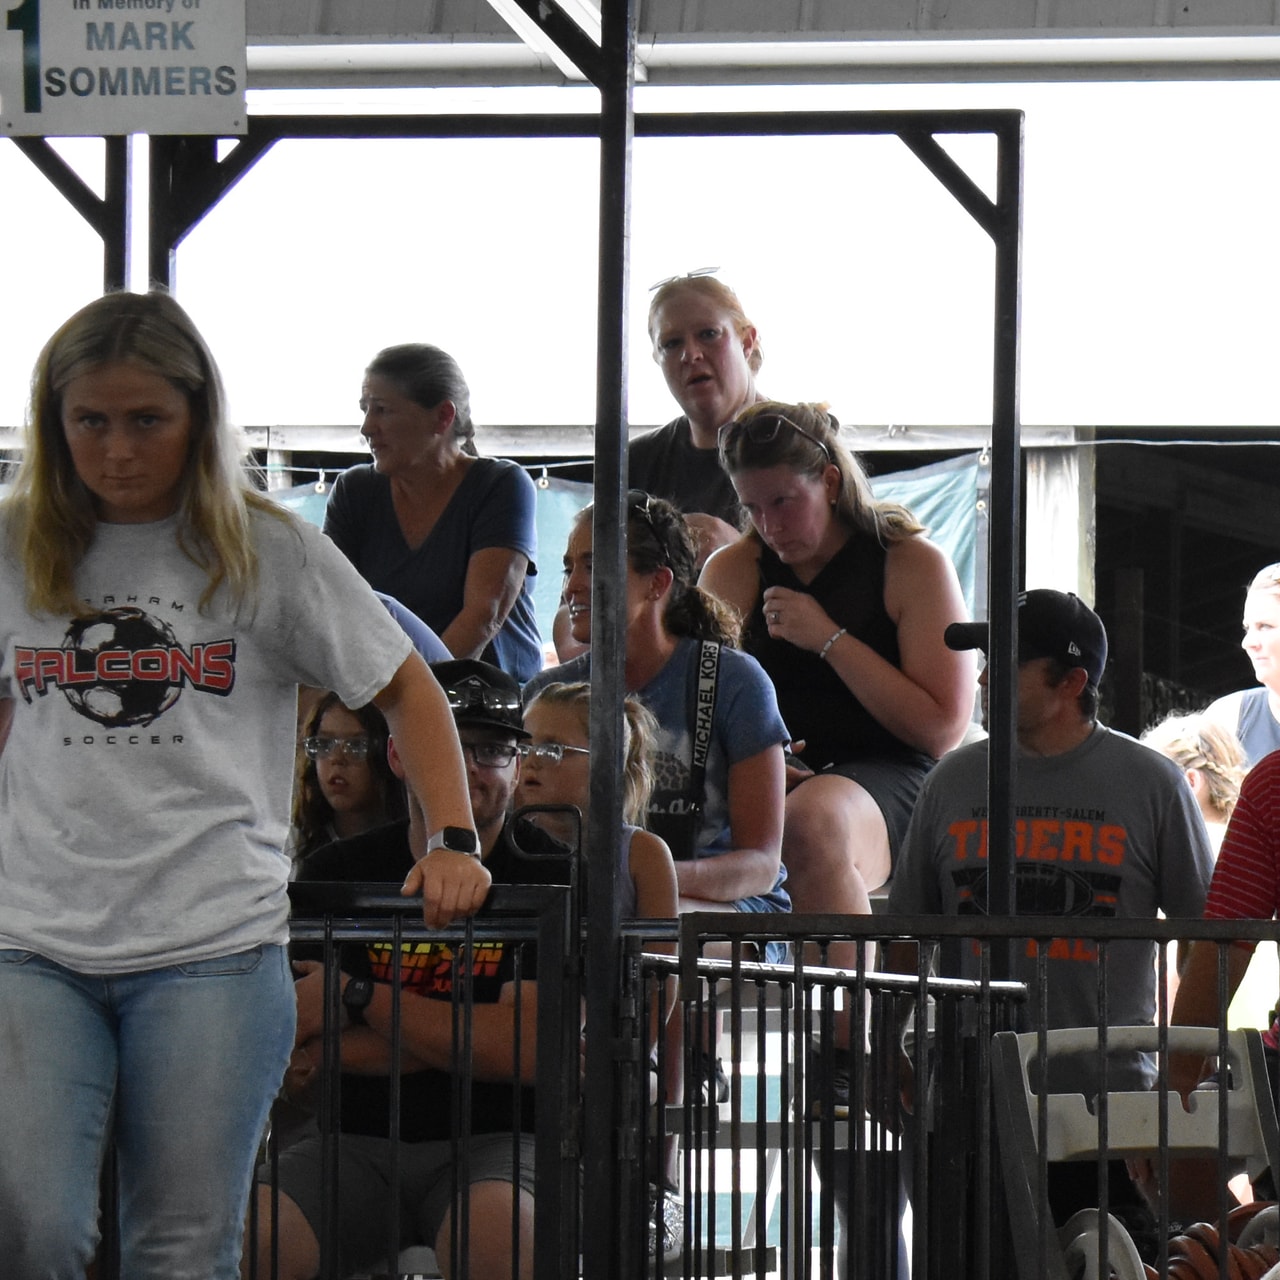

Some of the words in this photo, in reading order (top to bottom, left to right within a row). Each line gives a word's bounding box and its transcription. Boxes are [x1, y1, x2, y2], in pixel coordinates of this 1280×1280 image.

[7, 0, 41, 113] 1
[86, 22, 195, 50] MARK
[45, 66, 237, 97] SOMMERS
[15, 639, 236, 704] FALCONS
[700, 644, 718, 680] KORS
[64, 735, 184, 746] SOCCER
[693, 686, 714, 767] MICHAEL
[948, 819, 1127, 867] TIERS
